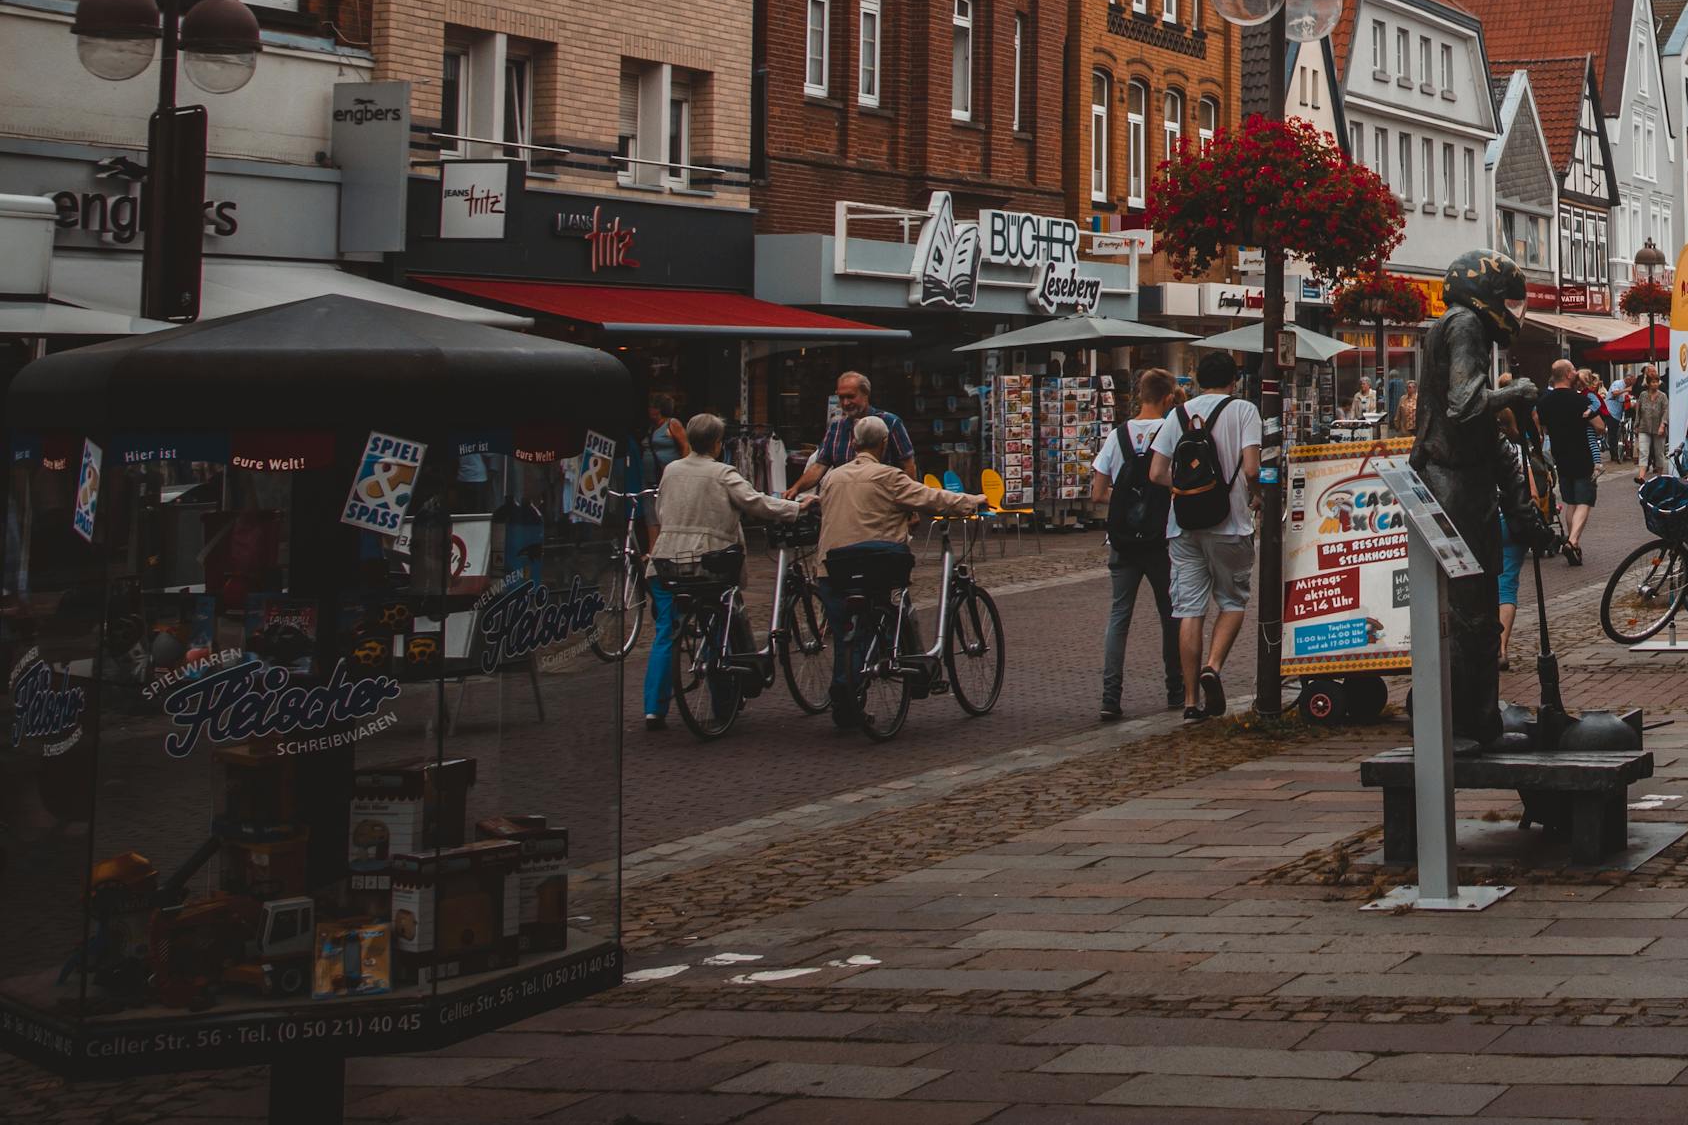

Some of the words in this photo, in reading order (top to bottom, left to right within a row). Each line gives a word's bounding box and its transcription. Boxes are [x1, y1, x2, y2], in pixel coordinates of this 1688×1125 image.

[333, 104, 401, 125] engbers
[444, 188, 469, 199] JEANS
[464, 184, 505, 217] fritz
[54, 189, 237, 244] engrs
[585, 205, 640, 274] fritz
[990, 212, 1078, 264] BÜCHER
[1041, 262, 1101, 310] Leseberg
[1560, 295, 1585, 303] VATTER
[125, 449, 155, 463] Hier
[160, 447, 177, 460] ist
[369, 435, 421, 463] SPIEL
[459, 443, 476, 455] Hier
[478, 441, 489, 452] ist
[515, 448, 533, 461] eure
[535, 451, 555, 462] Welt!
[586, 432, 614, 457] SPIEL
[233, 455, 264, 470] eure
[269, 457, 305, 471] Welt!
[346, 503, 400, 530] SPASS
[575, 495, 602, 519] SPASS
[1321, 541, 1347, 557] BAR,
[1338, 547, 1406, 566] STEAKHOUSE
[472, 569, 524, 611] PIELWAREN
[1295, 574, 1348, 592] Mittags-
[1304, 587, 1341, 602] aktion
[1294, 600, 1328, 617] 12-14
[1332, 595, 1354, 609] Uhr
[481, 574, 605, 674] Fleischer
[142, 646, 243, 701] SPIELWAREN
[164, 656, 401, 758] Fleischer
[276, 711, 399, 757] SCHREIBWAREN
[439, 1001, 474, 1025] Celler
[476, 995, 497, 1014] Str.
[499, 986, 513, 1005] 56
[521, 976, 540, 997] Tel.
[542, 971, 553, 993] (0
[555, 968, 568, 984] 50
[570, 962, 587, 982] 21)
[589, 955, 602, 973] 40
[603, 951, 616, 969] 45
[86, 1034, 148, 1059] Celler
[154, 1033, 190, 1053] Str.
[197, 1029, 221, 1048] 56
[237, 1025, 272, 1044] Tel.
[278, 1021, 297, 1043] (0
[303, 1019, 327, 1038] 50
[331, 1015, 363, 1037] 21)
[369, 1014, 392, 1033] 40
[397, 1012, 421, 1031] 45
